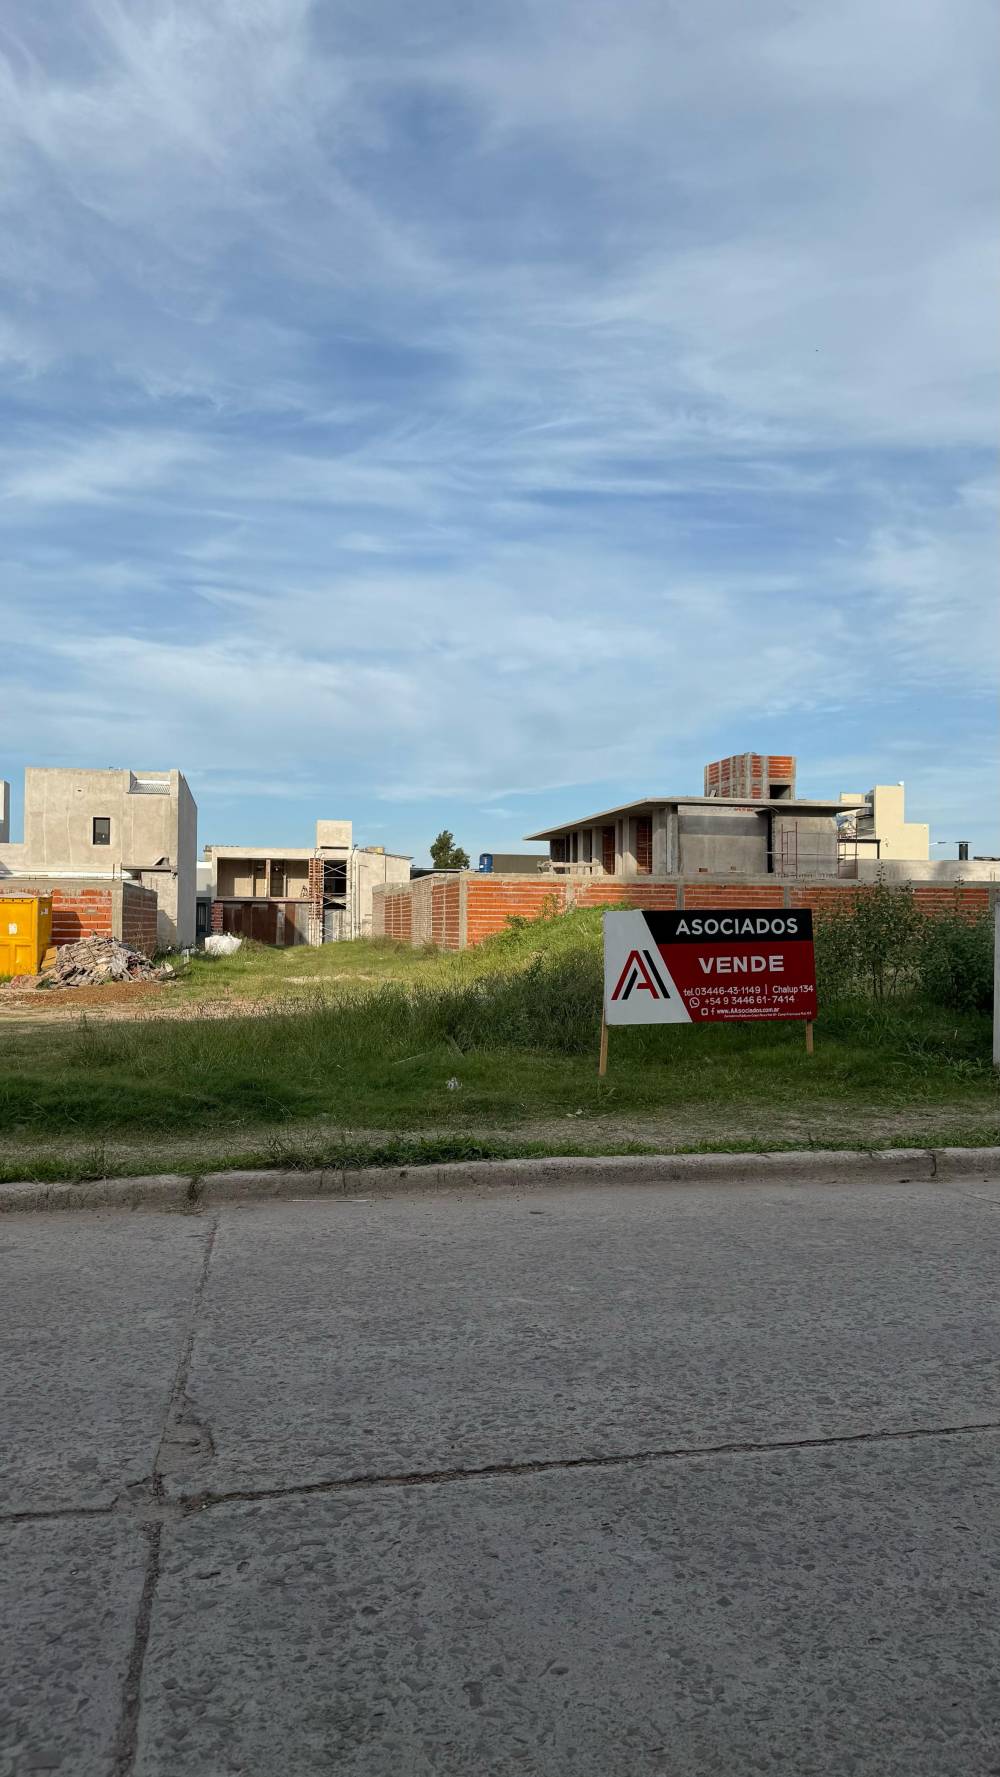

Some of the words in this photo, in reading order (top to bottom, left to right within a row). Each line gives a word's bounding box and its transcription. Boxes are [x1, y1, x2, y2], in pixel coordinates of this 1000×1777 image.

[675, 917, 799, 936] ASOCIADOS
[698, 955, 785, 974] VENDE
[704, 997, 721, 1006] +54
[723, 996, 729, 1005] 9
[731, 996, 755, 1005] 3446
